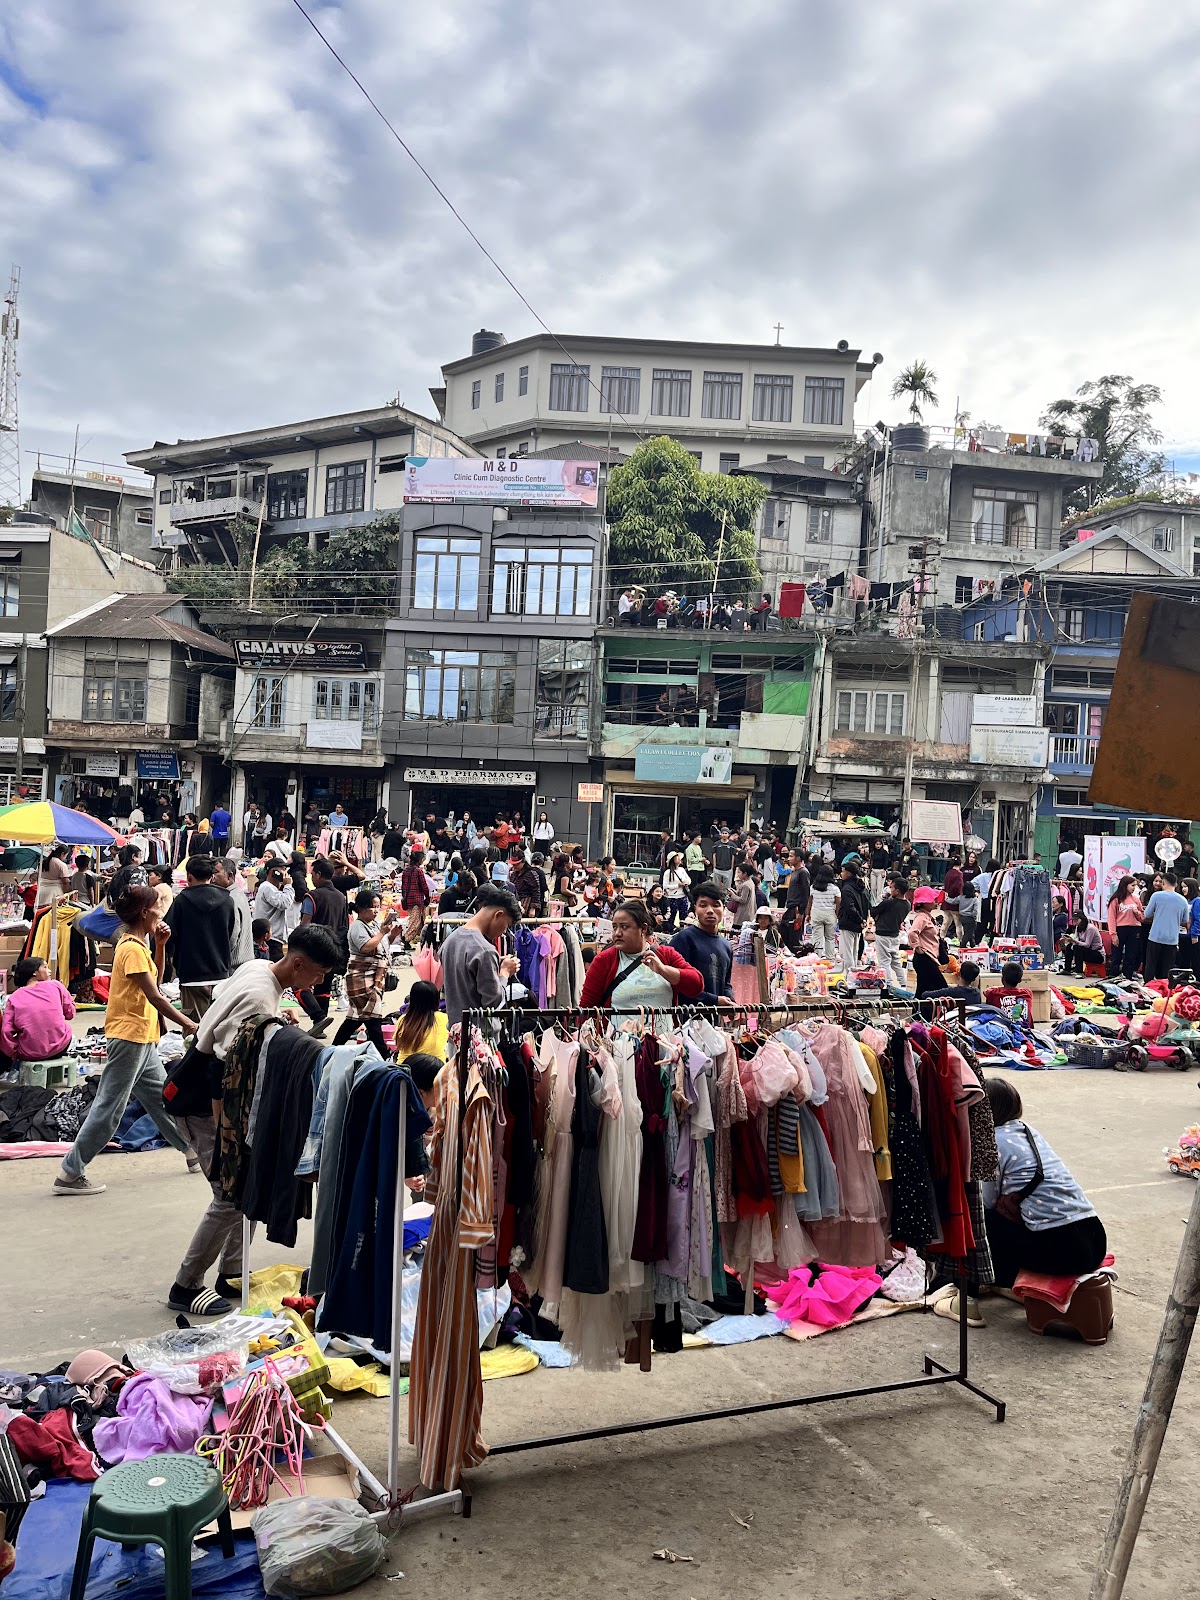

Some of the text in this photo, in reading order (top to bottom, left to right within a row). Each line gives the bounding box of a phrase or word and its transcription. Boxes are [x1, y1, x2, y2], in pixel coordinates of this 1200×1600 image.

[484, 461, 518, 472] M & D
[473, 474, 488, 482] Cum
[490, 475, 524, 483] Diagnostic
[238, 641, 316, 655] CALITUS
